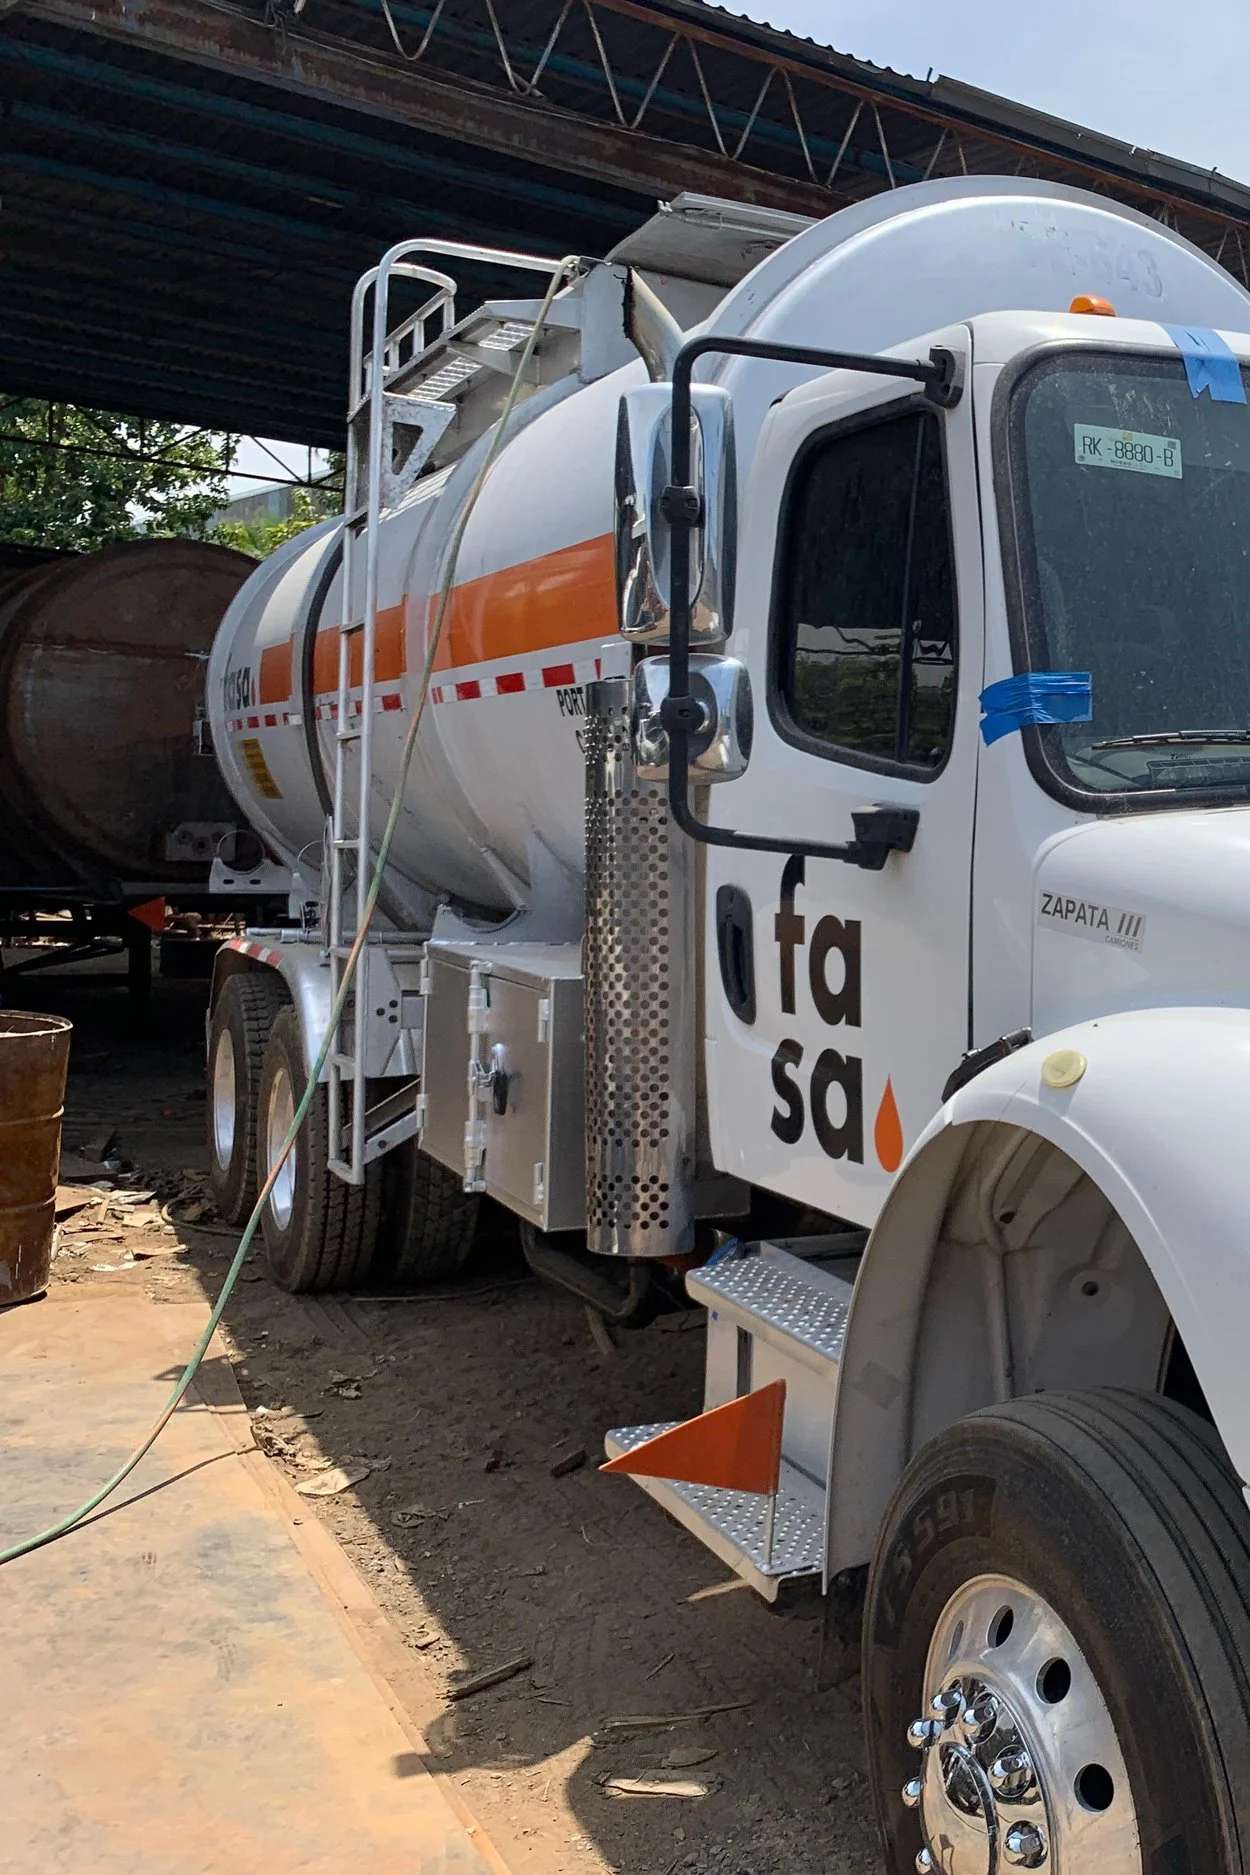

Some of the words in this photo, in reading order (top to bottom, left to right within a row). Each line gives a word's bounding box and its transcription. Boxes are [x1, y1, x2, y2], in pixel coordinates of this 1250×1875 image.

[1082, 435, 1174, 468] RK-8880-B
[1041, 893, 1110, 931] ZAPATA
[774, 853, 862, 1028] fa
[1104, 935, 1139, 951] CAMIONES
[771, 1037, 864, 1165] sa
